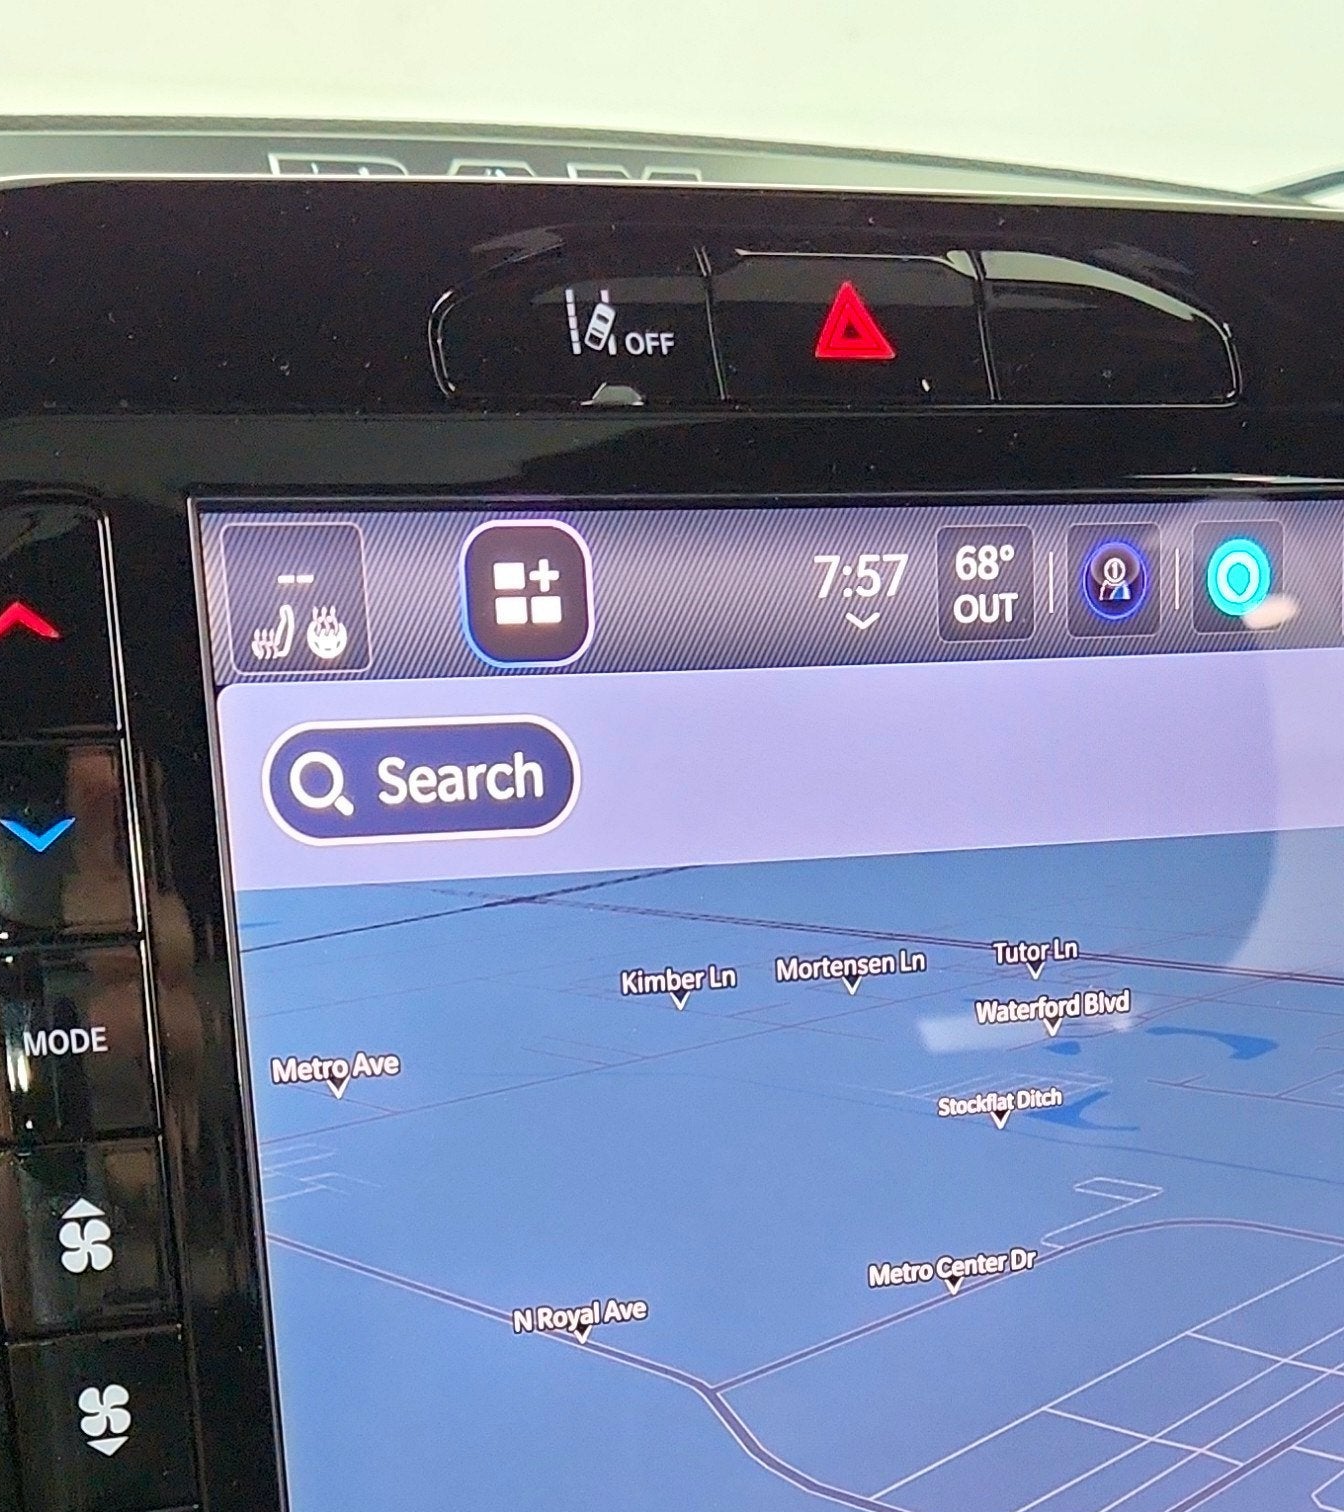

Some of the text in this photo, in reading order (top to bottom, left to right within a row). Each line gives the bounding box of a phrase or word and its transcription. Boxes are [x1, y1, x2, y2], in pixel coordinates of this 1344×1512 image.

[624, 331, 675, 356] OFF
[813, 552, 908, 599] 7:57
[952, 591, 1019, 624] OUT
[376, 750, 545, 806] Search
[776, 950, 926, 982] Mortensen Ln
[994, 939, 1079, 966] Tutor Ln
[621, 965, 737, 996] Kimber Ln
[976, 988, 1131, 1025] Waterford Blvd
[24, 1026, 109, 1057] MODE
[271, 1051, 400, 1083] Metro Ave
[937, 1087, 1063, 1117] Stockflat Ditch
[869, 1248, 1037, 1288] Metro Center Dr
[513, 1298, 648, 1333] N Royal Ave
